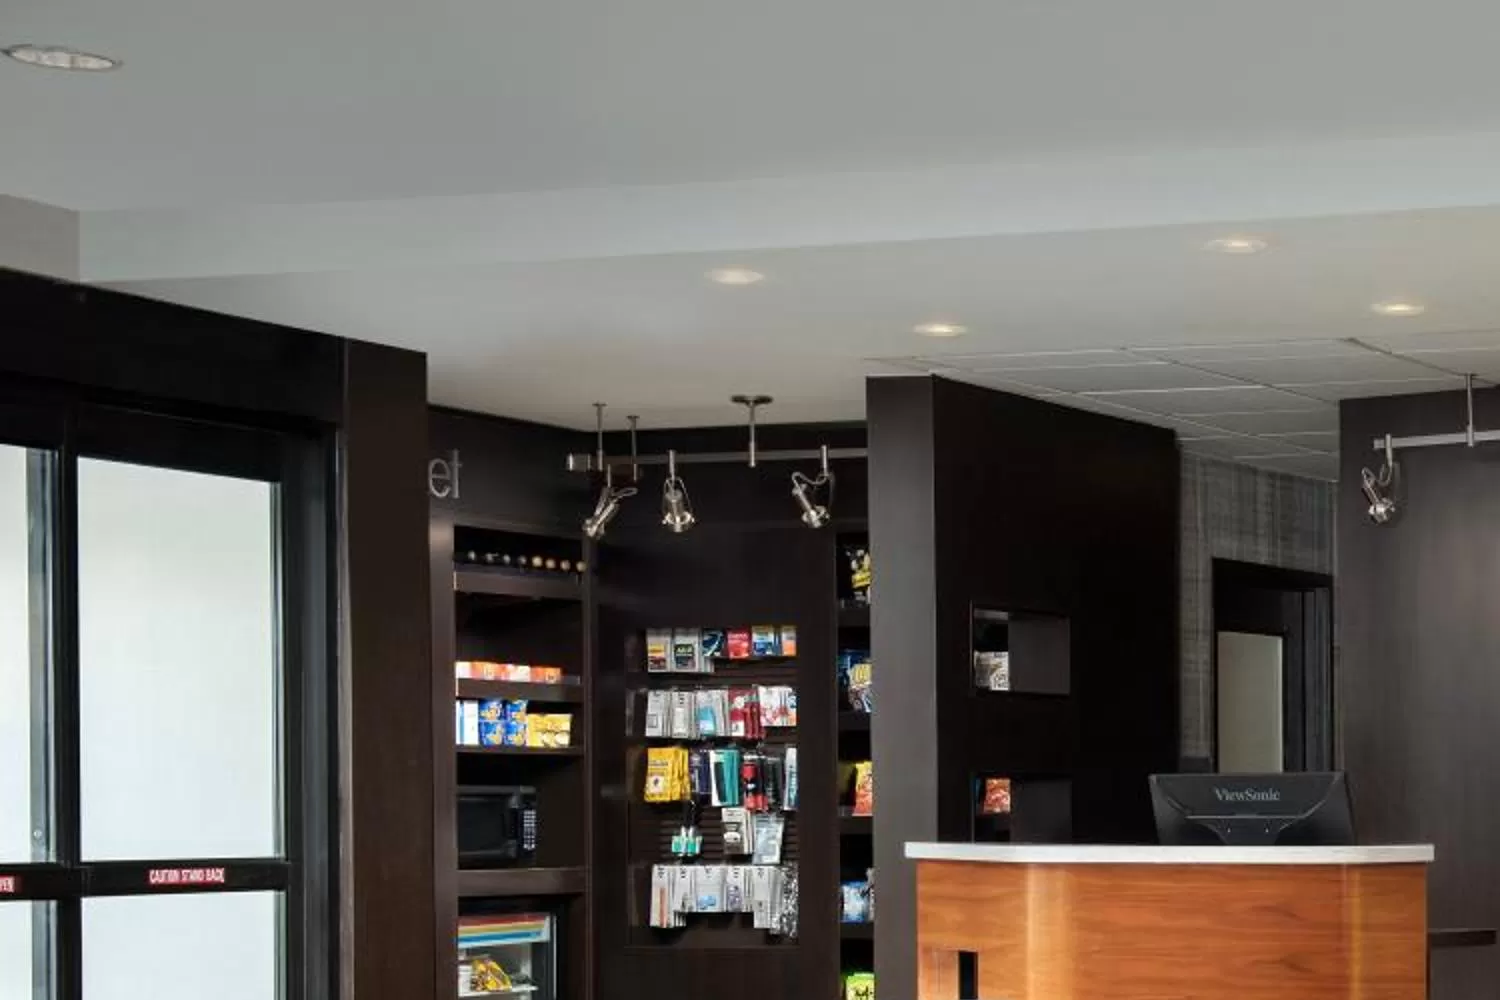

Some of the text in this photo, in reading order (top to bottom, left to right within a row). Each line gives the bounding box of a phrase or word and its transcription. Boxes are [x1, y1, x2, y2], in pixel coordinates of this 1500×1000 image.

[1214, 786, 1281, 801] ViewSonic
[149, 869, 180, 884] CAUTION
[206, 868, 225, 883] BACK
